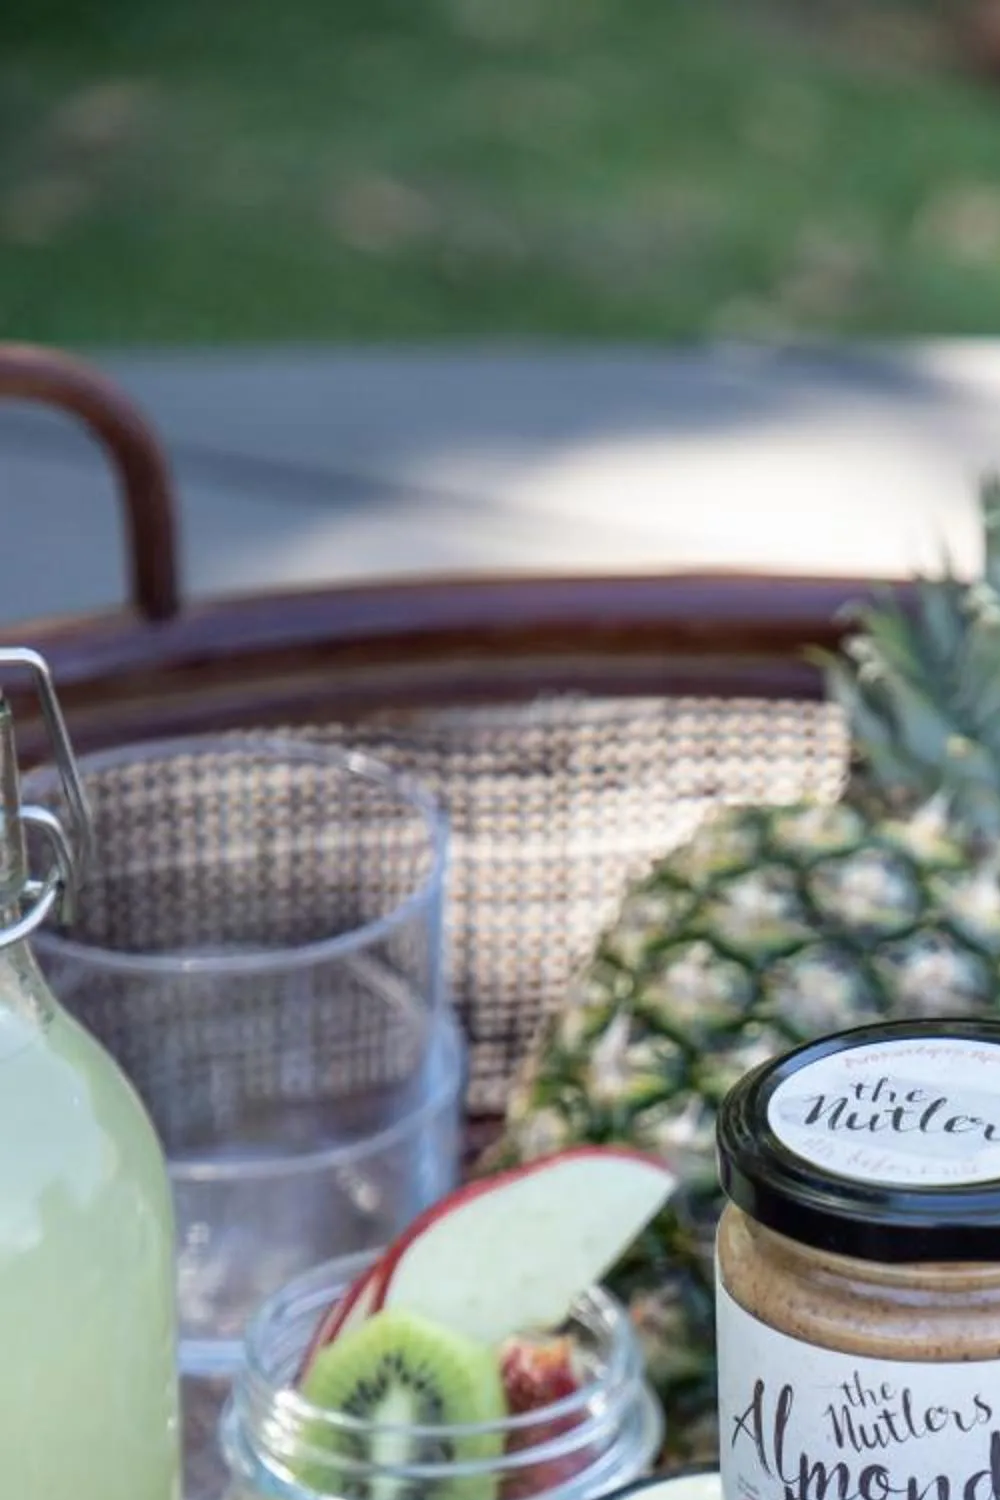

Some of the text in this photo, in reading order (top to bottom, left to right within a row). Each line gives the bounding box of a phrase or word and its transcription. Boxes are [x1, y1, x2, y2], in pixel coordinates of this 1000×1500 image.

[850, 1077, 925, 1103] the
[841, 1370, 897, 1408] the
[823, 1387, 993, 1452] Nutlers
